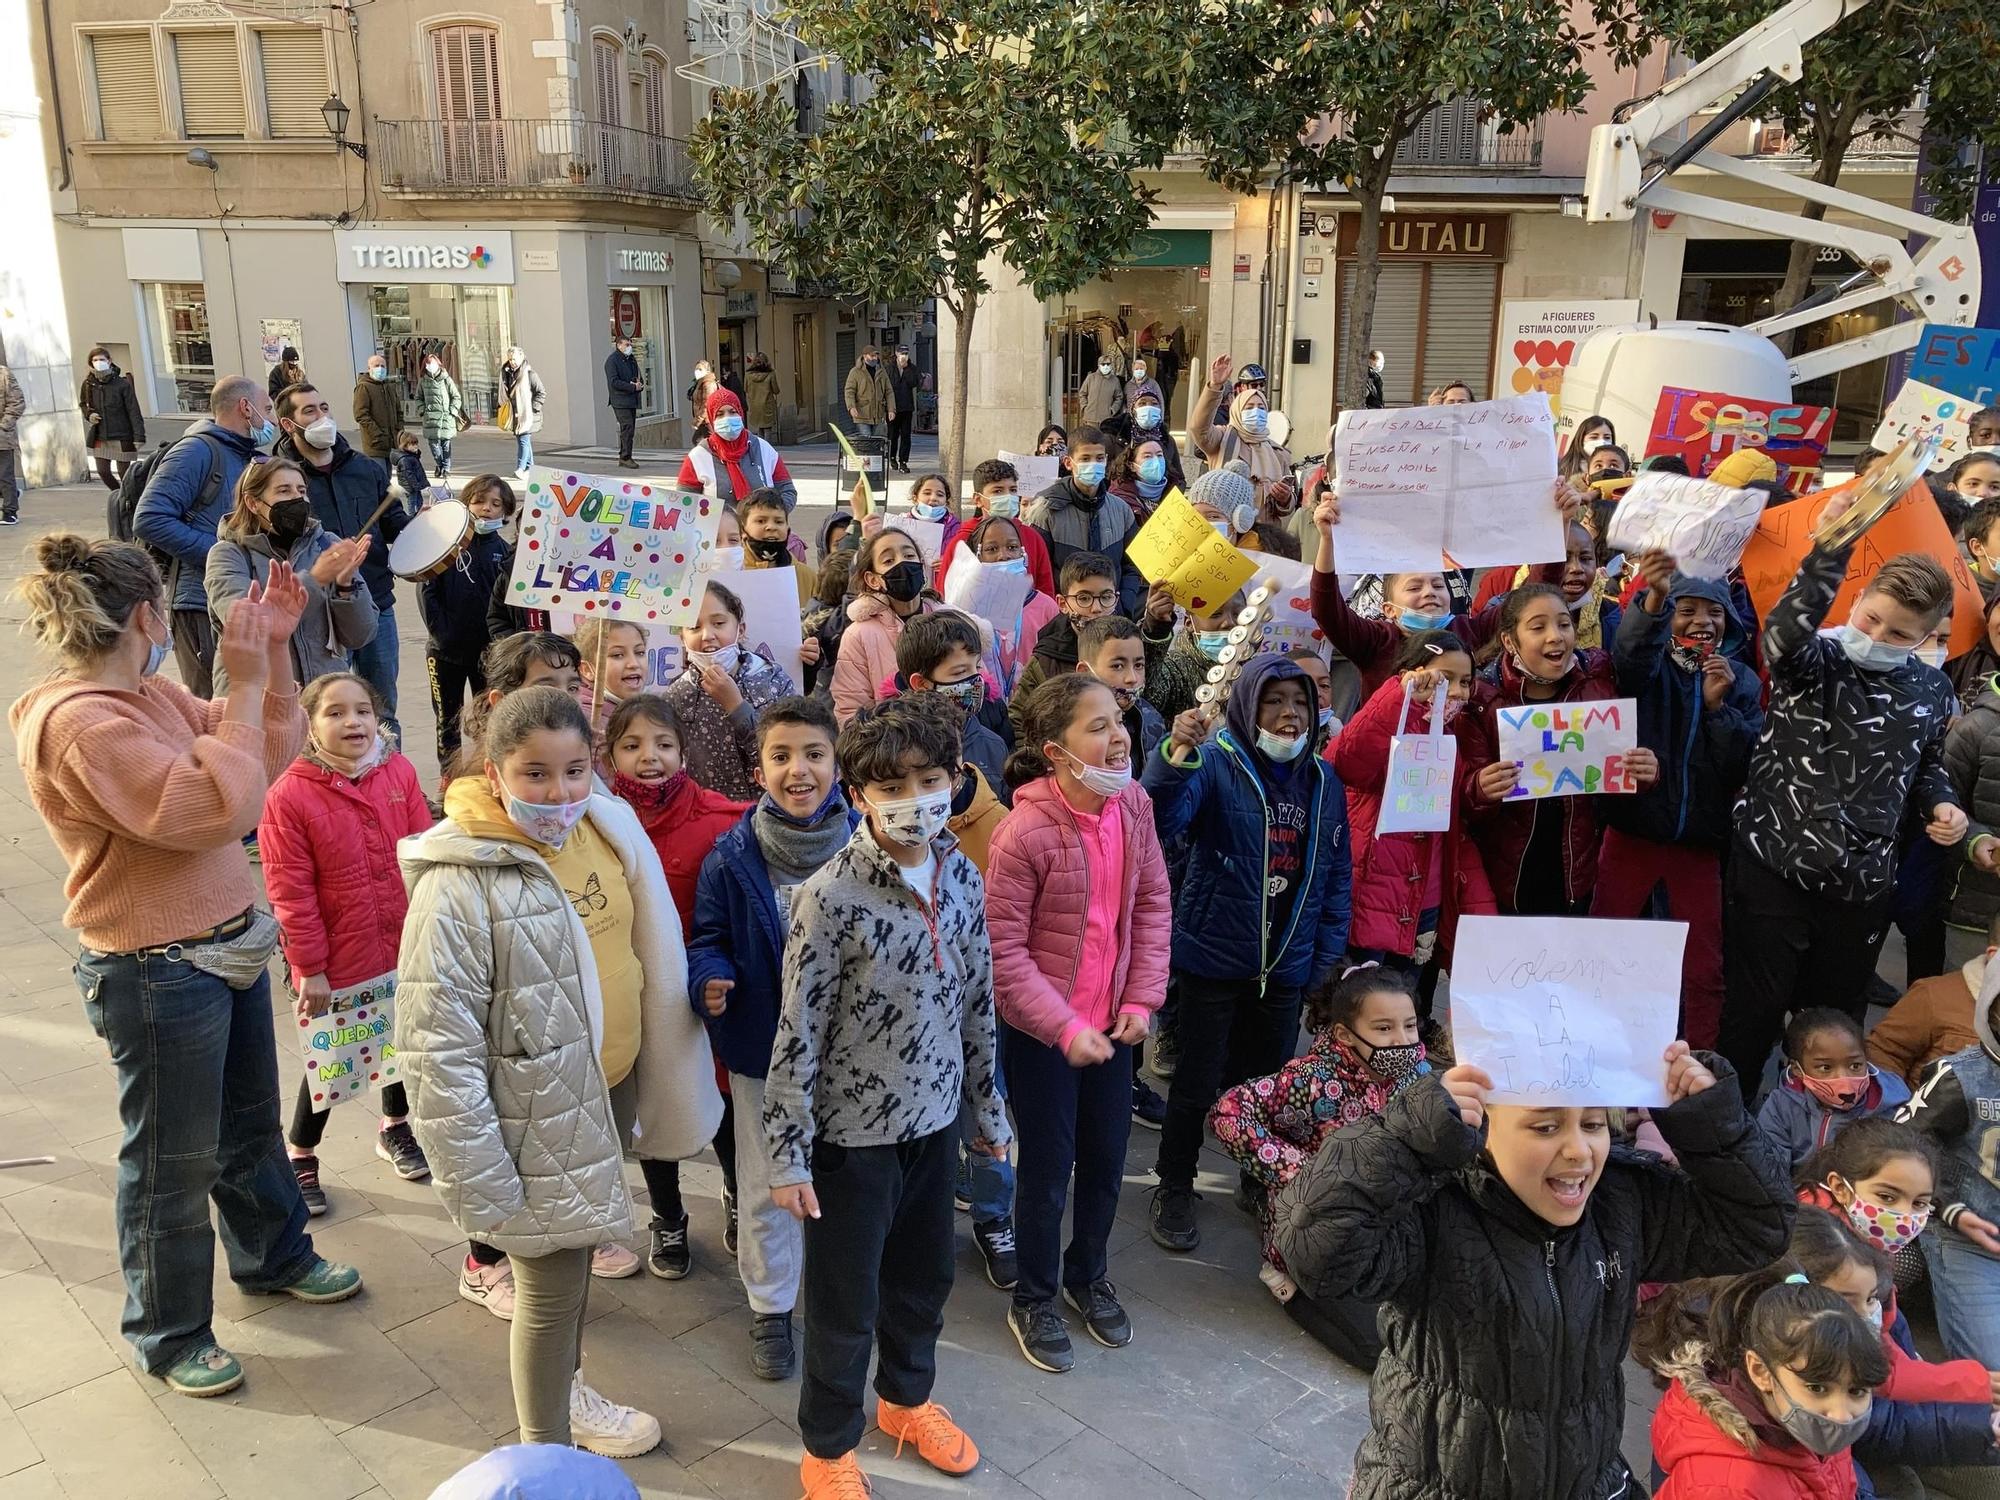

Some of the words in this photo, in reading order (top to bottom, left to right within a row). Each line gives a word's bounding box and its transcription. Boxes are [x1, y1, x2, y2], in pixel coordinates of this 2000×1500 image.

[1981, 211, 1997, 223] de
[1380, 222, 1486, 252] UTAU
[1519, 325, 1552, 334] ESTIMA
[1554, 325, 1576, 334] COM
[1542, 312, 1549, 321] A
[1550, 312, 1595, 321] FIGUERES
[550, 484, 681, 531] VOLEM
[1170, 499, 1210, 540] VOLEM
[1213, 542, 1237, 565] QUE
[589, 535, 616, 561] A
[1263, 625, 1306, 639] OLEM
[1500, 705, 1621, 731] VOLEM
[1542, 730, 1584, 753] LA
[1506, 755, 1637, 798] ISABEL
[1548, 994, 1567, 1022] A
[1535, 1024, 1572, 1047] LA
[843, 1072, 887, 1104] ROCK
[762, 1100, 789, 1133] OCK
